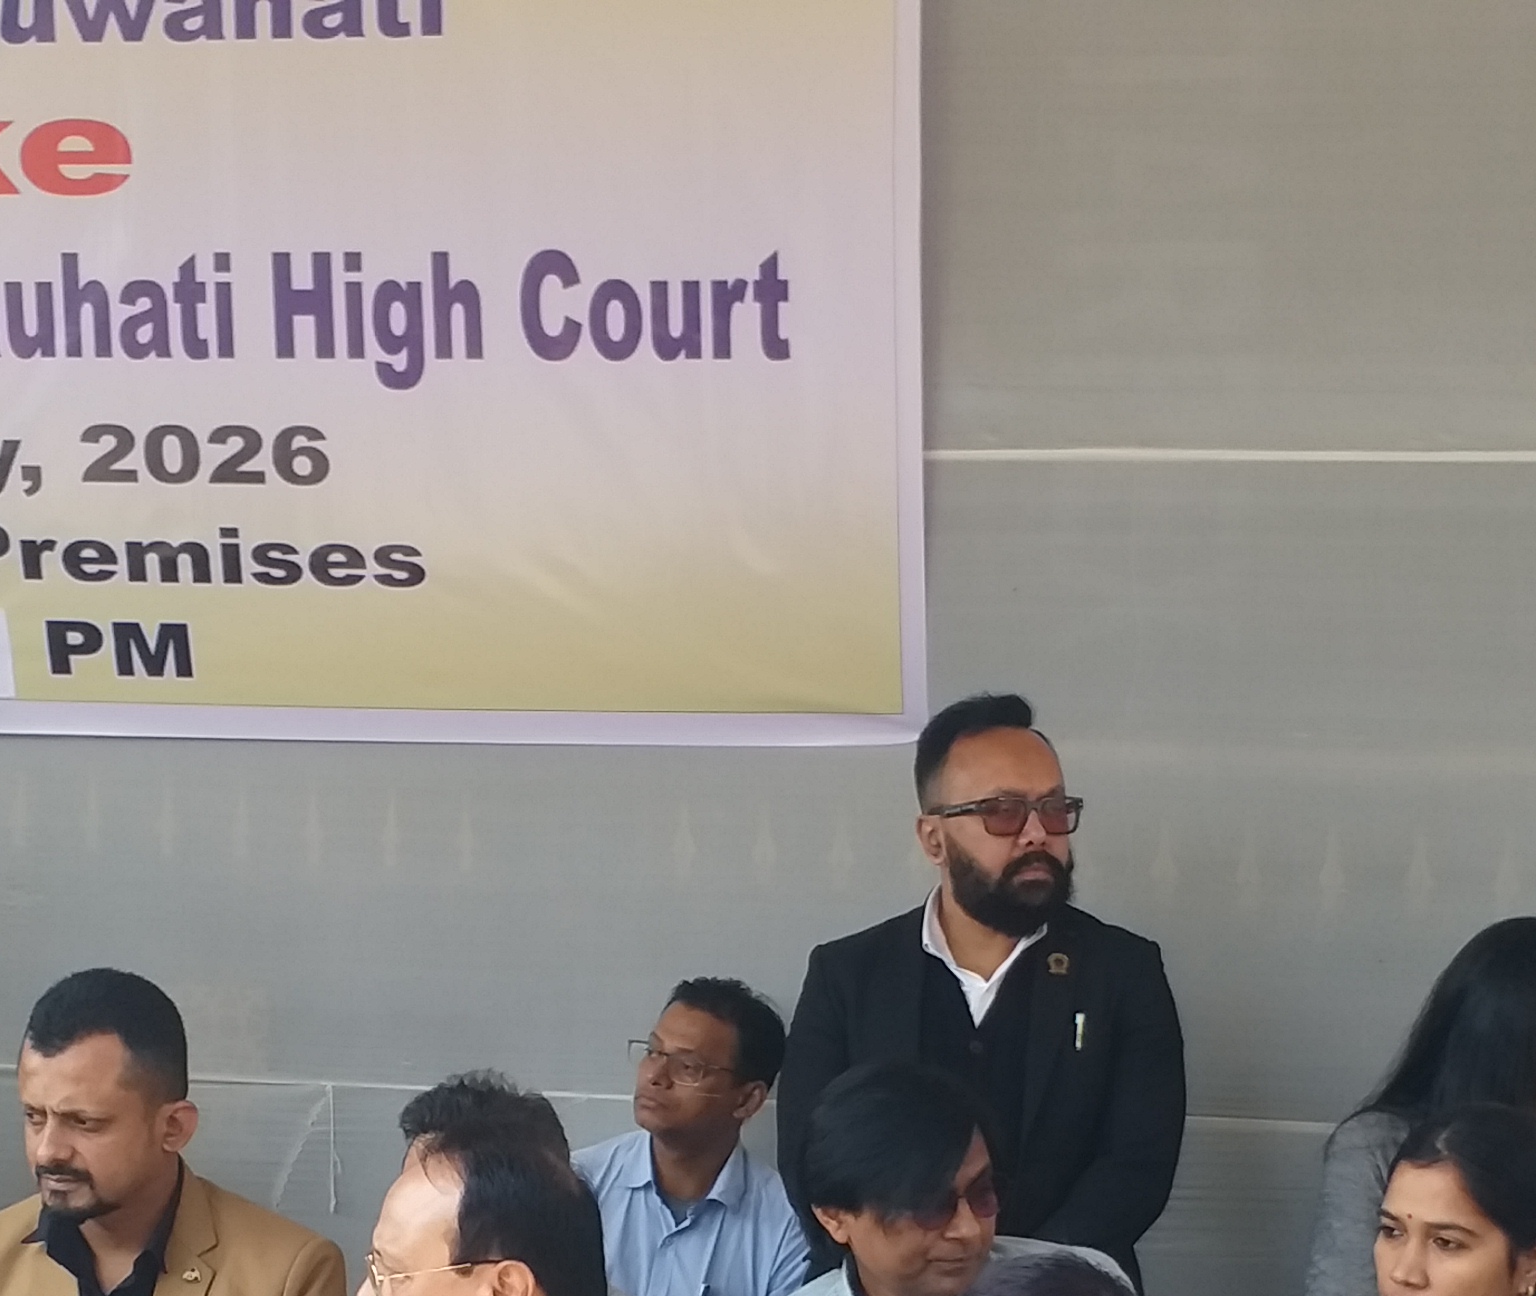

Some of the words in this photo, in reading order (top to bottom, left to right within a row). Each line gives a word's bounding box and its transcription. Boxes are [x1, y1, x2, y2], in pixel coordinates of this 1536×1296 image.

[270, 251, 483, 391] High
[520, 249, 792, 362] Court
[81, 423, 332, 490] 2026
[44, 619, 195, 679] PM
